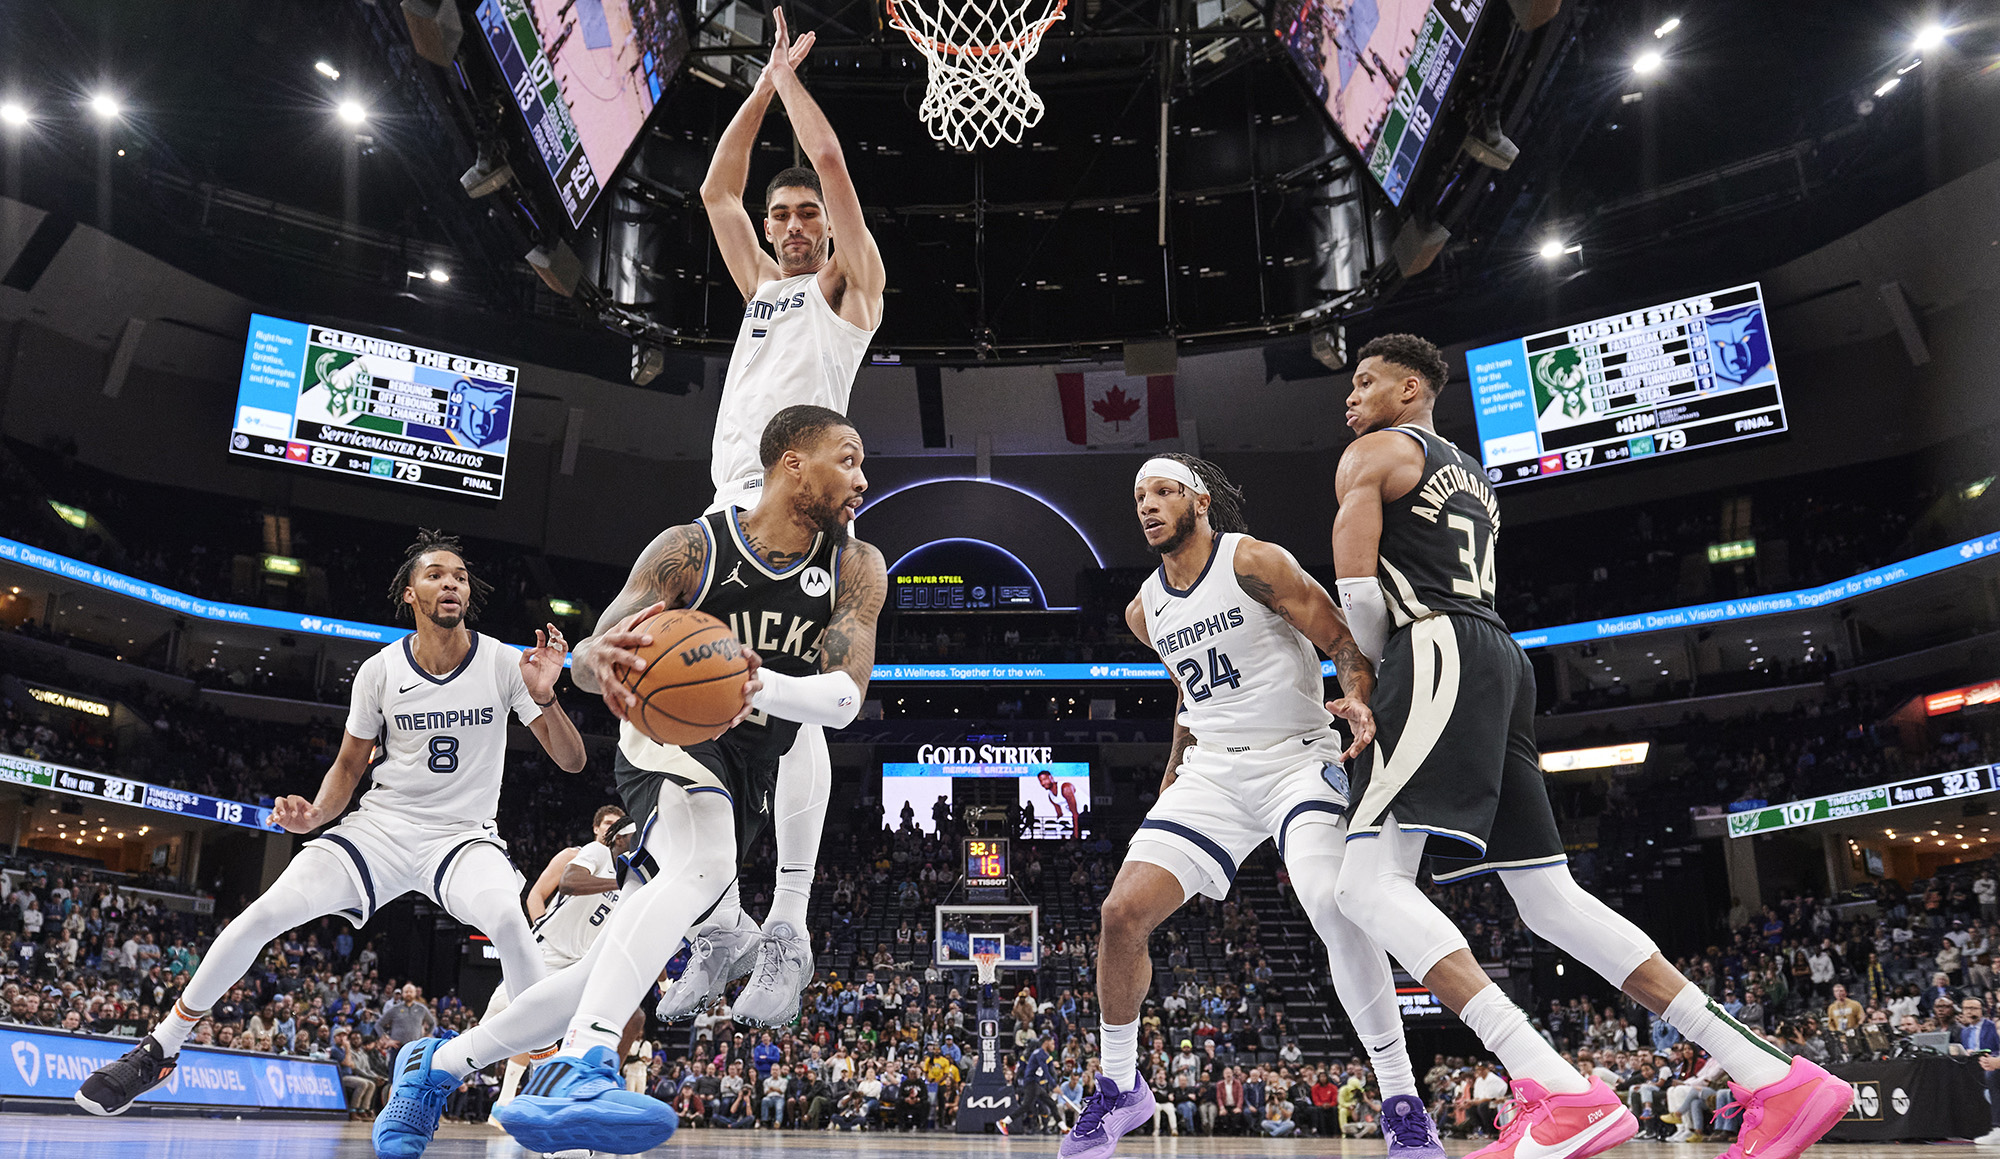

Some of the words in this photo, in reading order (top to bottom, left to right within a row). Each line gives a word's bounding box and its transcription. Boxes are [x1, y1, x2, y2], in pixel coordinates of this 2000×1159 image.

[529, 49, 553, 91] 107
[514, 71, 536, 111] 113
[1394, 77, 1417, 120] 107
[1409, 104, 1432, 142] 113
[1568, 313, 1645, 343] HUSTLE
[1646, 298, 1714, 325] STATS
[318, 331, 412, 362] CLEANING
[415, 350, 449, 369] THE
[452, 359, 509, 381] GLASS
[1620, 356, 1676, 377] TURNOVERS
[1642, 367, 1695, 386] TURNOVERS
[378, 391, 395, 403] OFF
[395, 394, 440, 412] REBOUNDS
[389, 380, 434, 398] REBOUNDS
[451, 392, 463, 404] 40
[373, 404, 390, 413] 2ND
[391, 407, 424, 421] CHANCE
[425, 413, 441, 425] PTS
[416, 446, 430, 461] by
[1565, 448, 1594, 470] 87
[1654, 429, 1687, 452] 79
[1735, 415, 1774, 433] FINAL
[311, 447, 340, 467] 87
[395, 461, 422, 482] 79
[463, 476, 493, 490] FINAL
[1447, 513, 1496, 600] 34
[21, 548, 57, 570] Dental,
[60, 560, 91, 580] Vision
[92, 571, 101, 583] &
[102, 573, 148, 598] Wellness.
[150, 588, 192, 611] Together
[192, 601, 207, 615] for
[208, 605, 226, 618] the
[897, 576, 912, 584] BIG
[913, 576, 938, 584] RIVER
[938, 576, 963, 584] STEEL
[897, 586, 965, 608] EDGE
[1598, 619, 1645, 635] Medical,
[1646, 613, 1688, 631] Dental,
[1689, 604, 1724, 624] Vision
[1726, 604, 1737, 616] &
[1737, 598, 1796, 615] Wellness.
[1797, 587, 1845, 606] Together
[1846, 579, 1862, 595] for
[1863, 573, 1882, 588] the
[322, 624, 334, 633] of
[334, 624, 382, 640] Tennessee
[729, 610, 825, 663] UCKS
[1157, 607, 1244, 658] MEMPHIS
[894, 668, 902, 677] &
[903, 667, 948, 678] Wellness.
[950, 667, 990, 679] Together
[992, 667, 1005, 677] for
[1008, 667, 1023, 677] the
[1025, 667, 1046, 677] win.
[1110, 668, 1120, 677] of
[1121, 668, 1165, 677] Tennessee
[1176, 647, 1241, 702] 24
[65, 696, 110, 717] MINOLTA
[394, 707, 493, 730] MEMPHIS
[428, 736, 459, 773] 8
[917, 744, 976, 764] GOLD
[979, 744, 1053, 764] STRIKE
[0, 758, 43, 774] IMEOUTS:
[0, 767, 25, 780] OULS:
[943, 766, 981, 774] MEMPHIS
[984, 766, 1029, 774] GRIZZLIES
[103, 779, 135, 802] 32.6
[1941, 771, 1980, 796] 32.6
[215, 801, 243, 823] 113
[1779, 803, 1816, 826] 107
[970, 842, 997, 856] 32.1
[981, 855, 1001, 876] 16
[589, 903, 611, 927] 5
[182, 1066, 246, 1091] FANDUEL
[286, 1074, 337, 1096] FANDUEL
